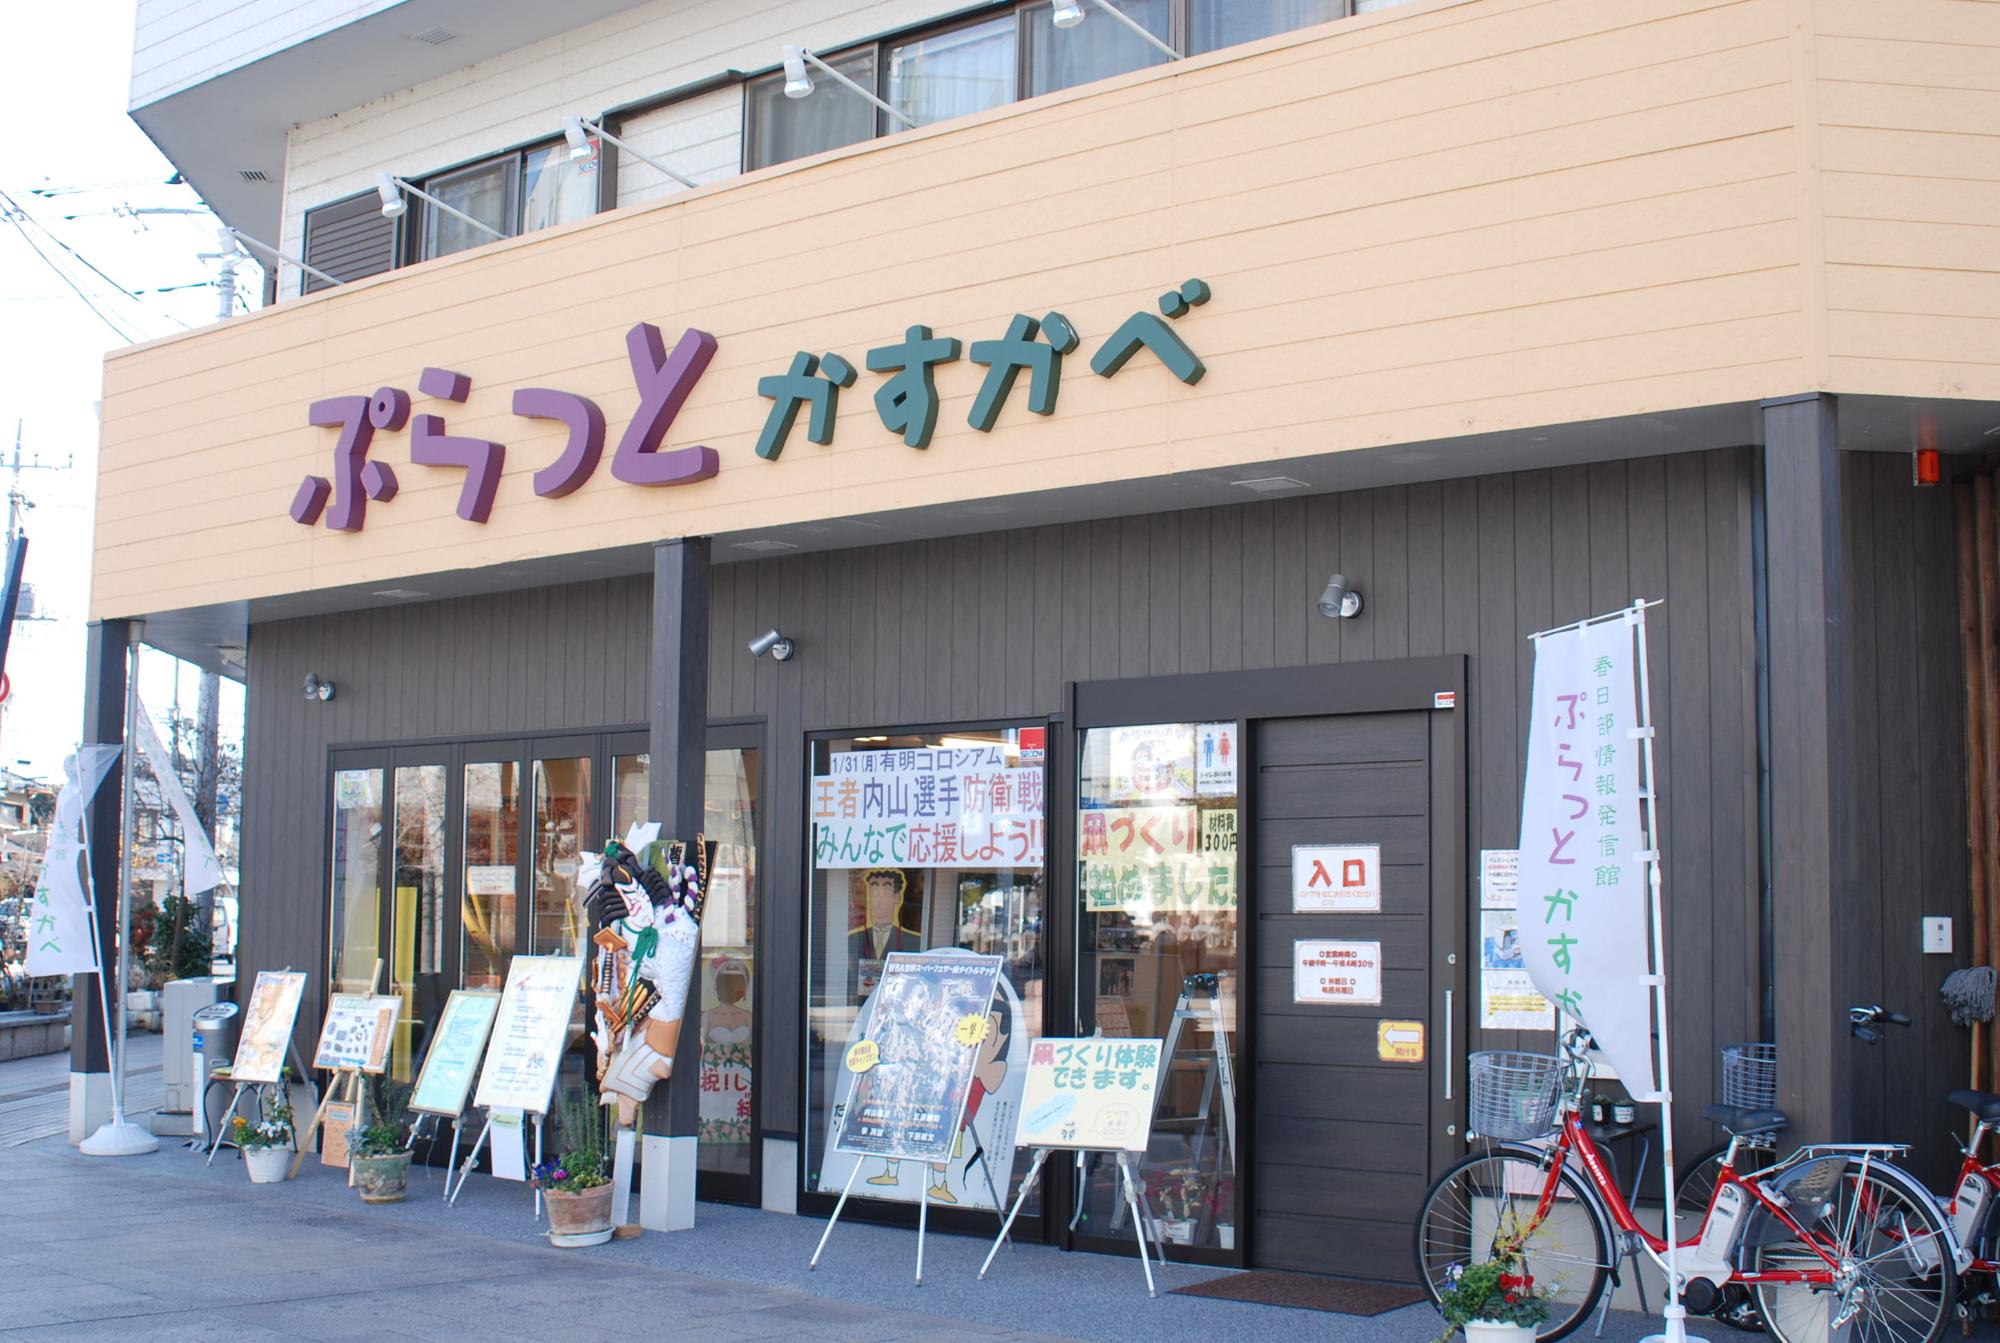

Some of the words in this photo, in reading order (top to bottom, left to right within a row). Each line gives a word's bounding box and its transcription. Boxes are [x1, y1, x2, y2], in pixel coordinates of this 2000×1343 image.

[289, 322, 720, 532] ぷらっと
[755, 277, 1211, 461] かすかべ
[1553, 692, 1589, 865] ぷらっと
[1593, 655, 1621, 887] 春日部情報発信館
[1308, 859, 1366, 887] 入口
[1053, 1067, 1150, 1091] できます。
